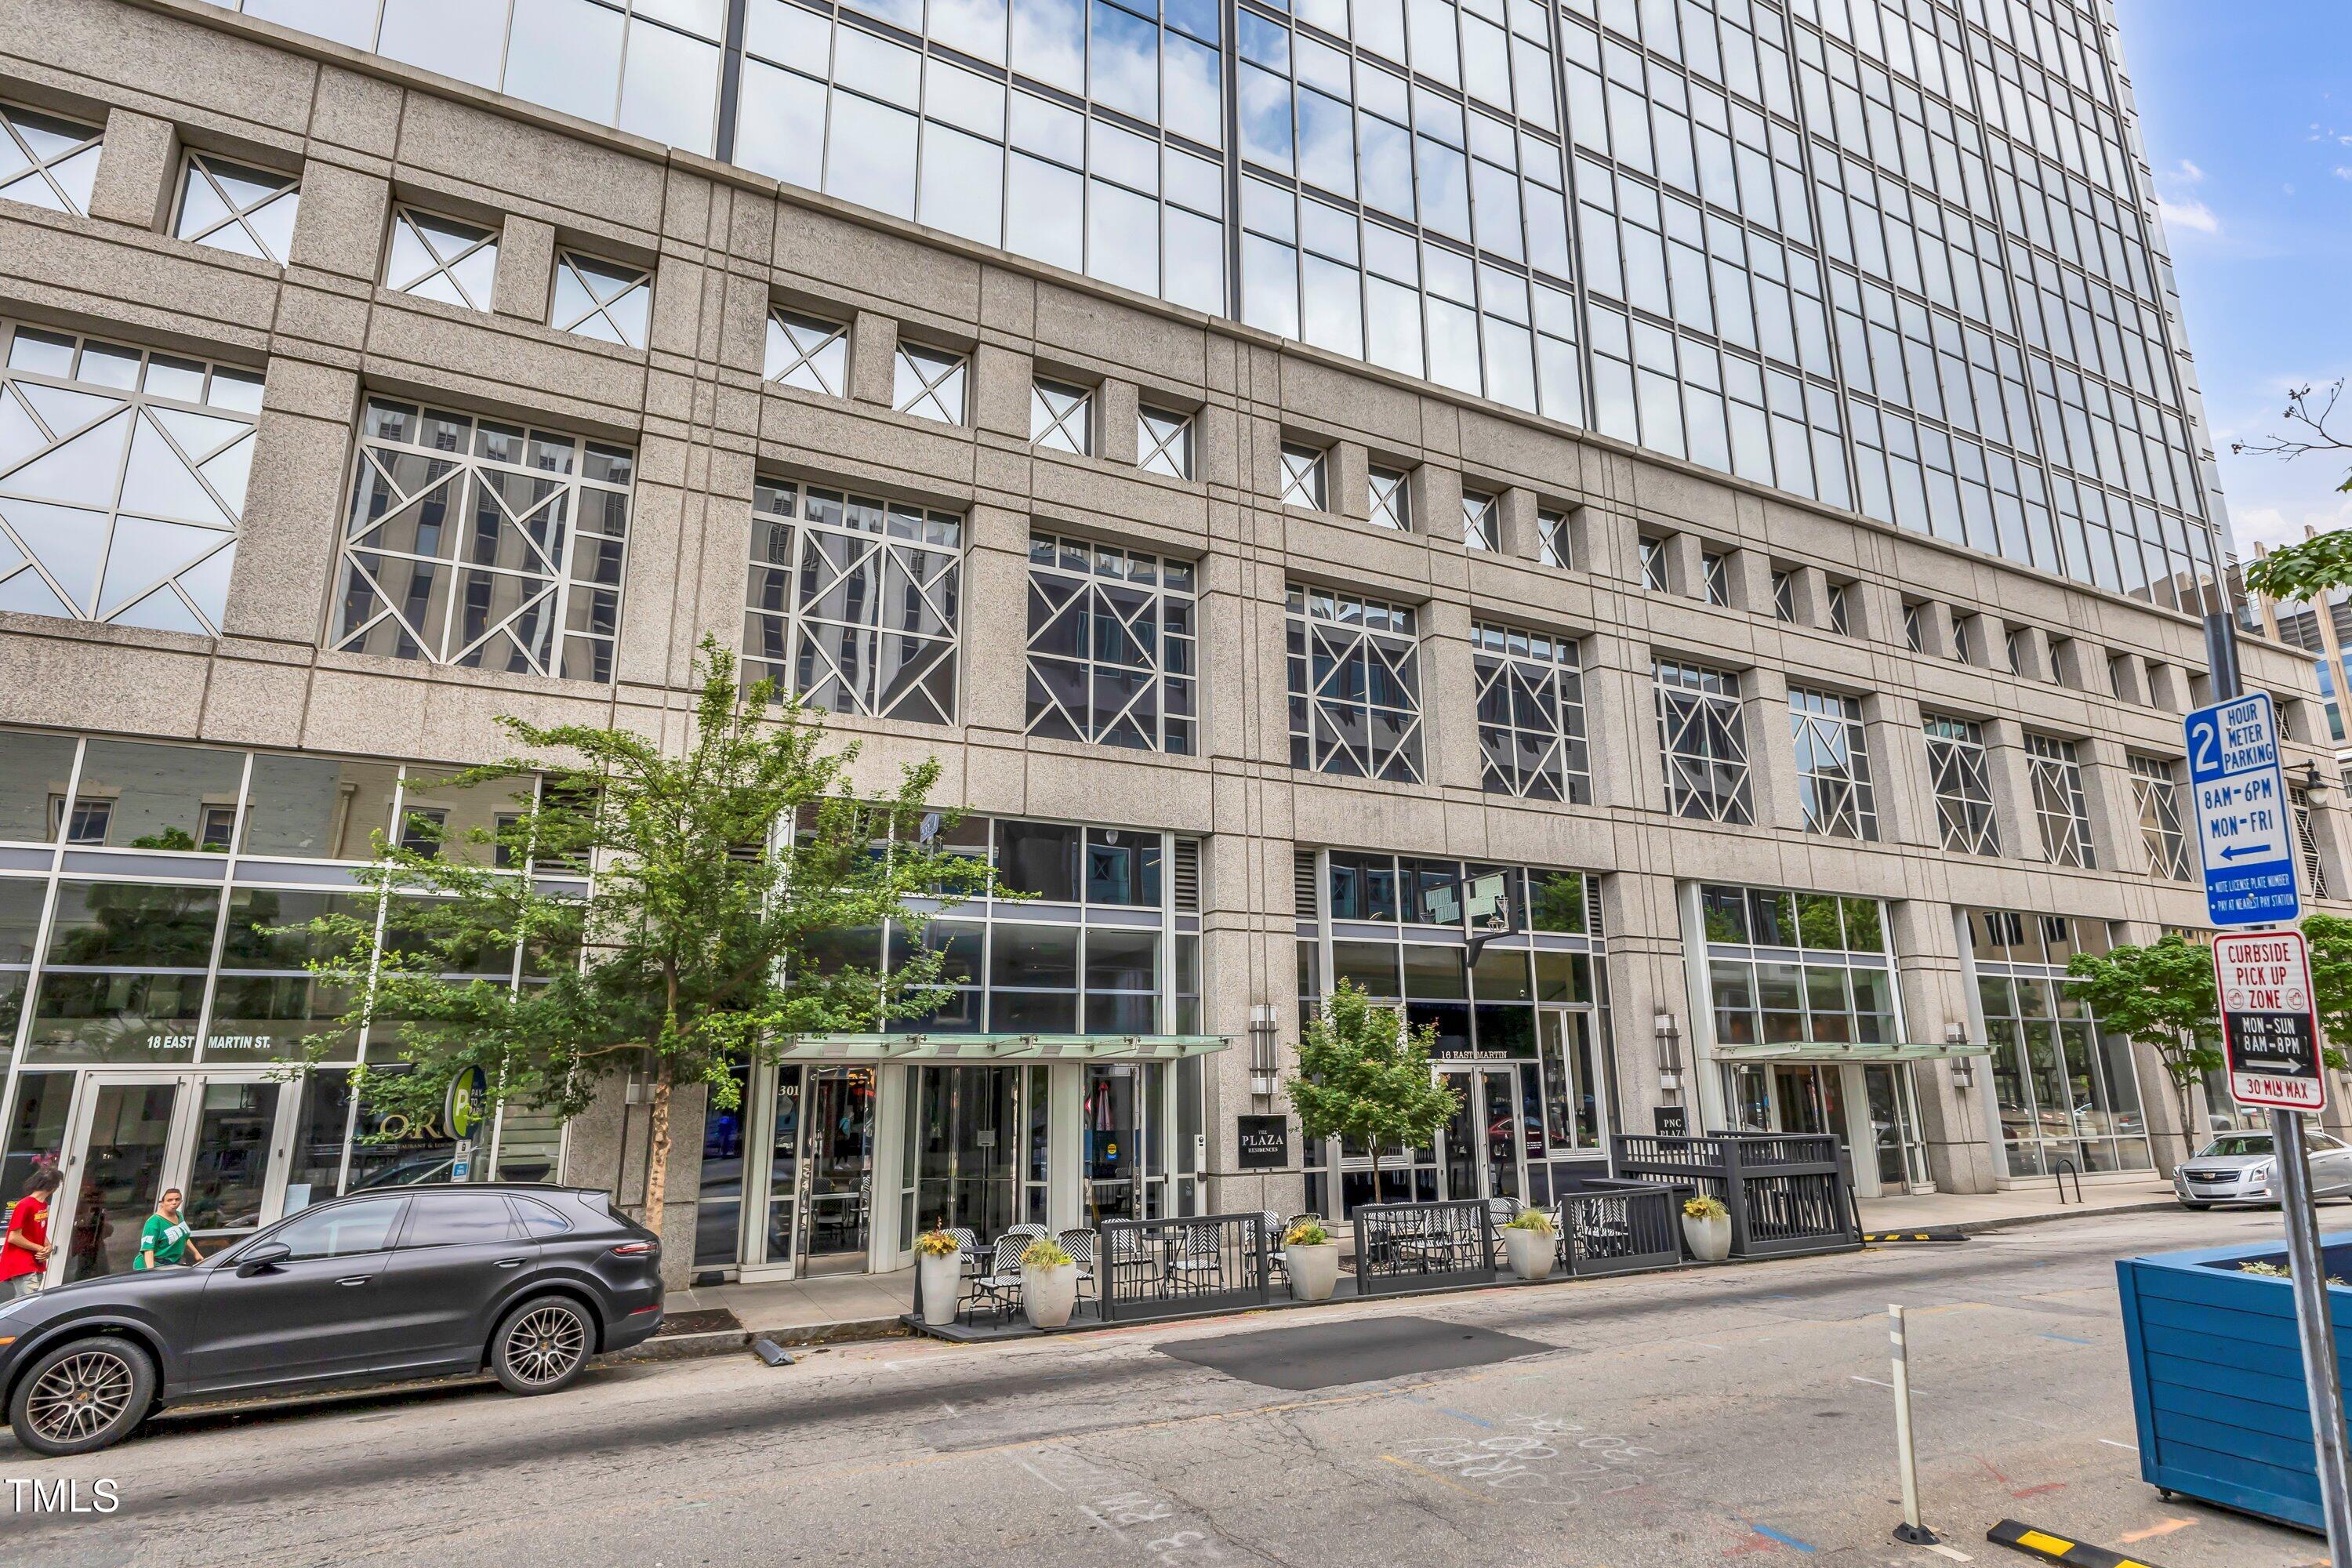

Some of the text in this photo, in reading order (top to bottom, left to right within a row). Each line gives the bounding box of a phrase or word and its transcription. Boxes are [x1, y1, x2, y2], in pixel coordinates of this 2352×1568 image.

[2227, 703, 2258, 726] HOUR
[2228, 724, 2263, 748] METER
[2192, 722, 2219, 773] 2
[2224, 743, 2273, 771] PARKING
[2205, 778, 2272, 810] 8AM-6PM
[2211, 810, 2273, 839] MON-FRI
[2215, 874, 2290, 893] NOTE LICENSE PLATE NUMBER
[2217, 894, 2295, 912] PAY AT NEAREST PAY STATION
[2228, 943, 2292, 963] CURBSIDE
[2237, 967, 2287, 985] PICK UP
[2249, 990, 2282, 1009] ZONE
[2242, 1017, 2296, 1035] MON-SUN
[147, 1036, 270, 1049] 18 EAST MARTIN ST.
[2244, 1036, 2300, 1054] 8AM-8PM
[1441, 1051, 1507, 1059] 16 EAST MARTIN
[778, 1085, 799, 1096] 301
[2247, 1079, 2308, 1099] 30 MIN MAX
[456, 1089, 470, 1116] P
[380, 1114, 459, 1140] OR
[1664, 1119, 1682, 1127] PNC
[1241, 1134, 1283, 1146] PLAZA
